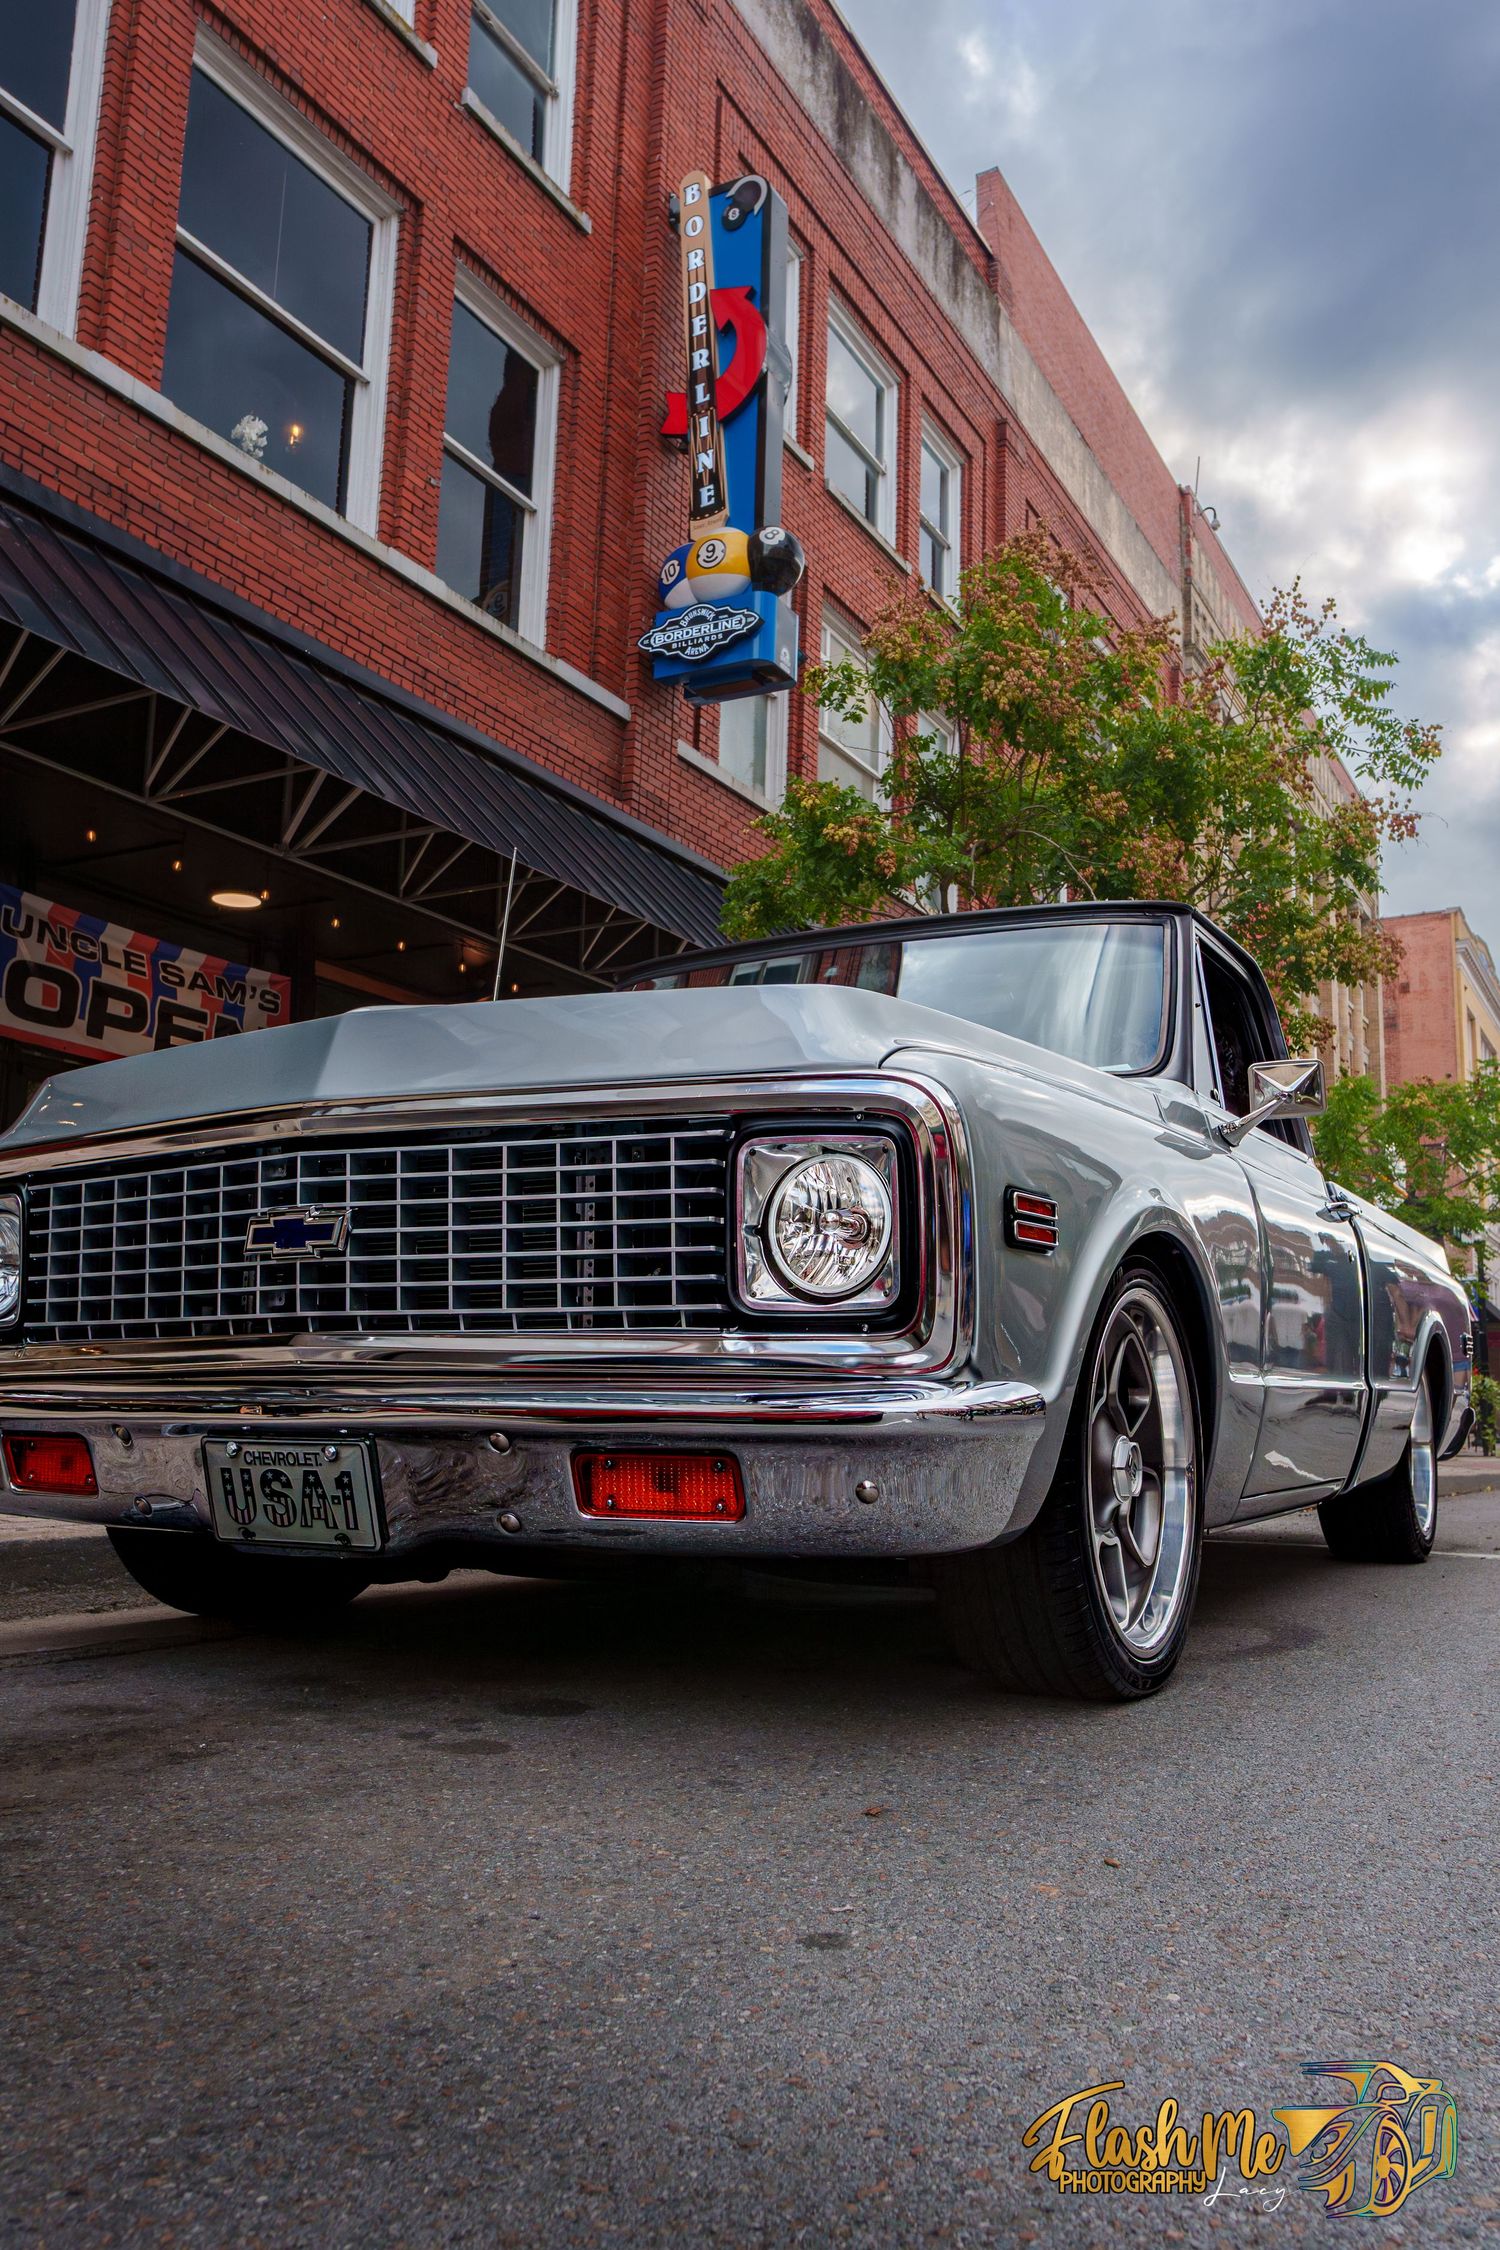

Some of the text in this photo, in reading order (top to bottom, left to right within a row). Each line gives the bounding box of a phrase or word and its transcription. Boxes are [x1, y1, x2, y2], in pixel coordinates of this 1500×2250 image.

[683, 182, 716, 509] BORDERLINE
[764, 529, 780, 540] 8
[704, 542, 717, 559] 9
[663, 563, 676, 582] 10
[679, 608, 717, 627] BRUNSWICK
[654, 617, 742, 645] BORDERLINE
[671, 633, 724, 649] BILLIARDS
[684, 643, 710, 656] ARENA
[1, 904, 282, 1015] UNCLE SAM'S
[220, 1467, 360, 1530] USA-1
